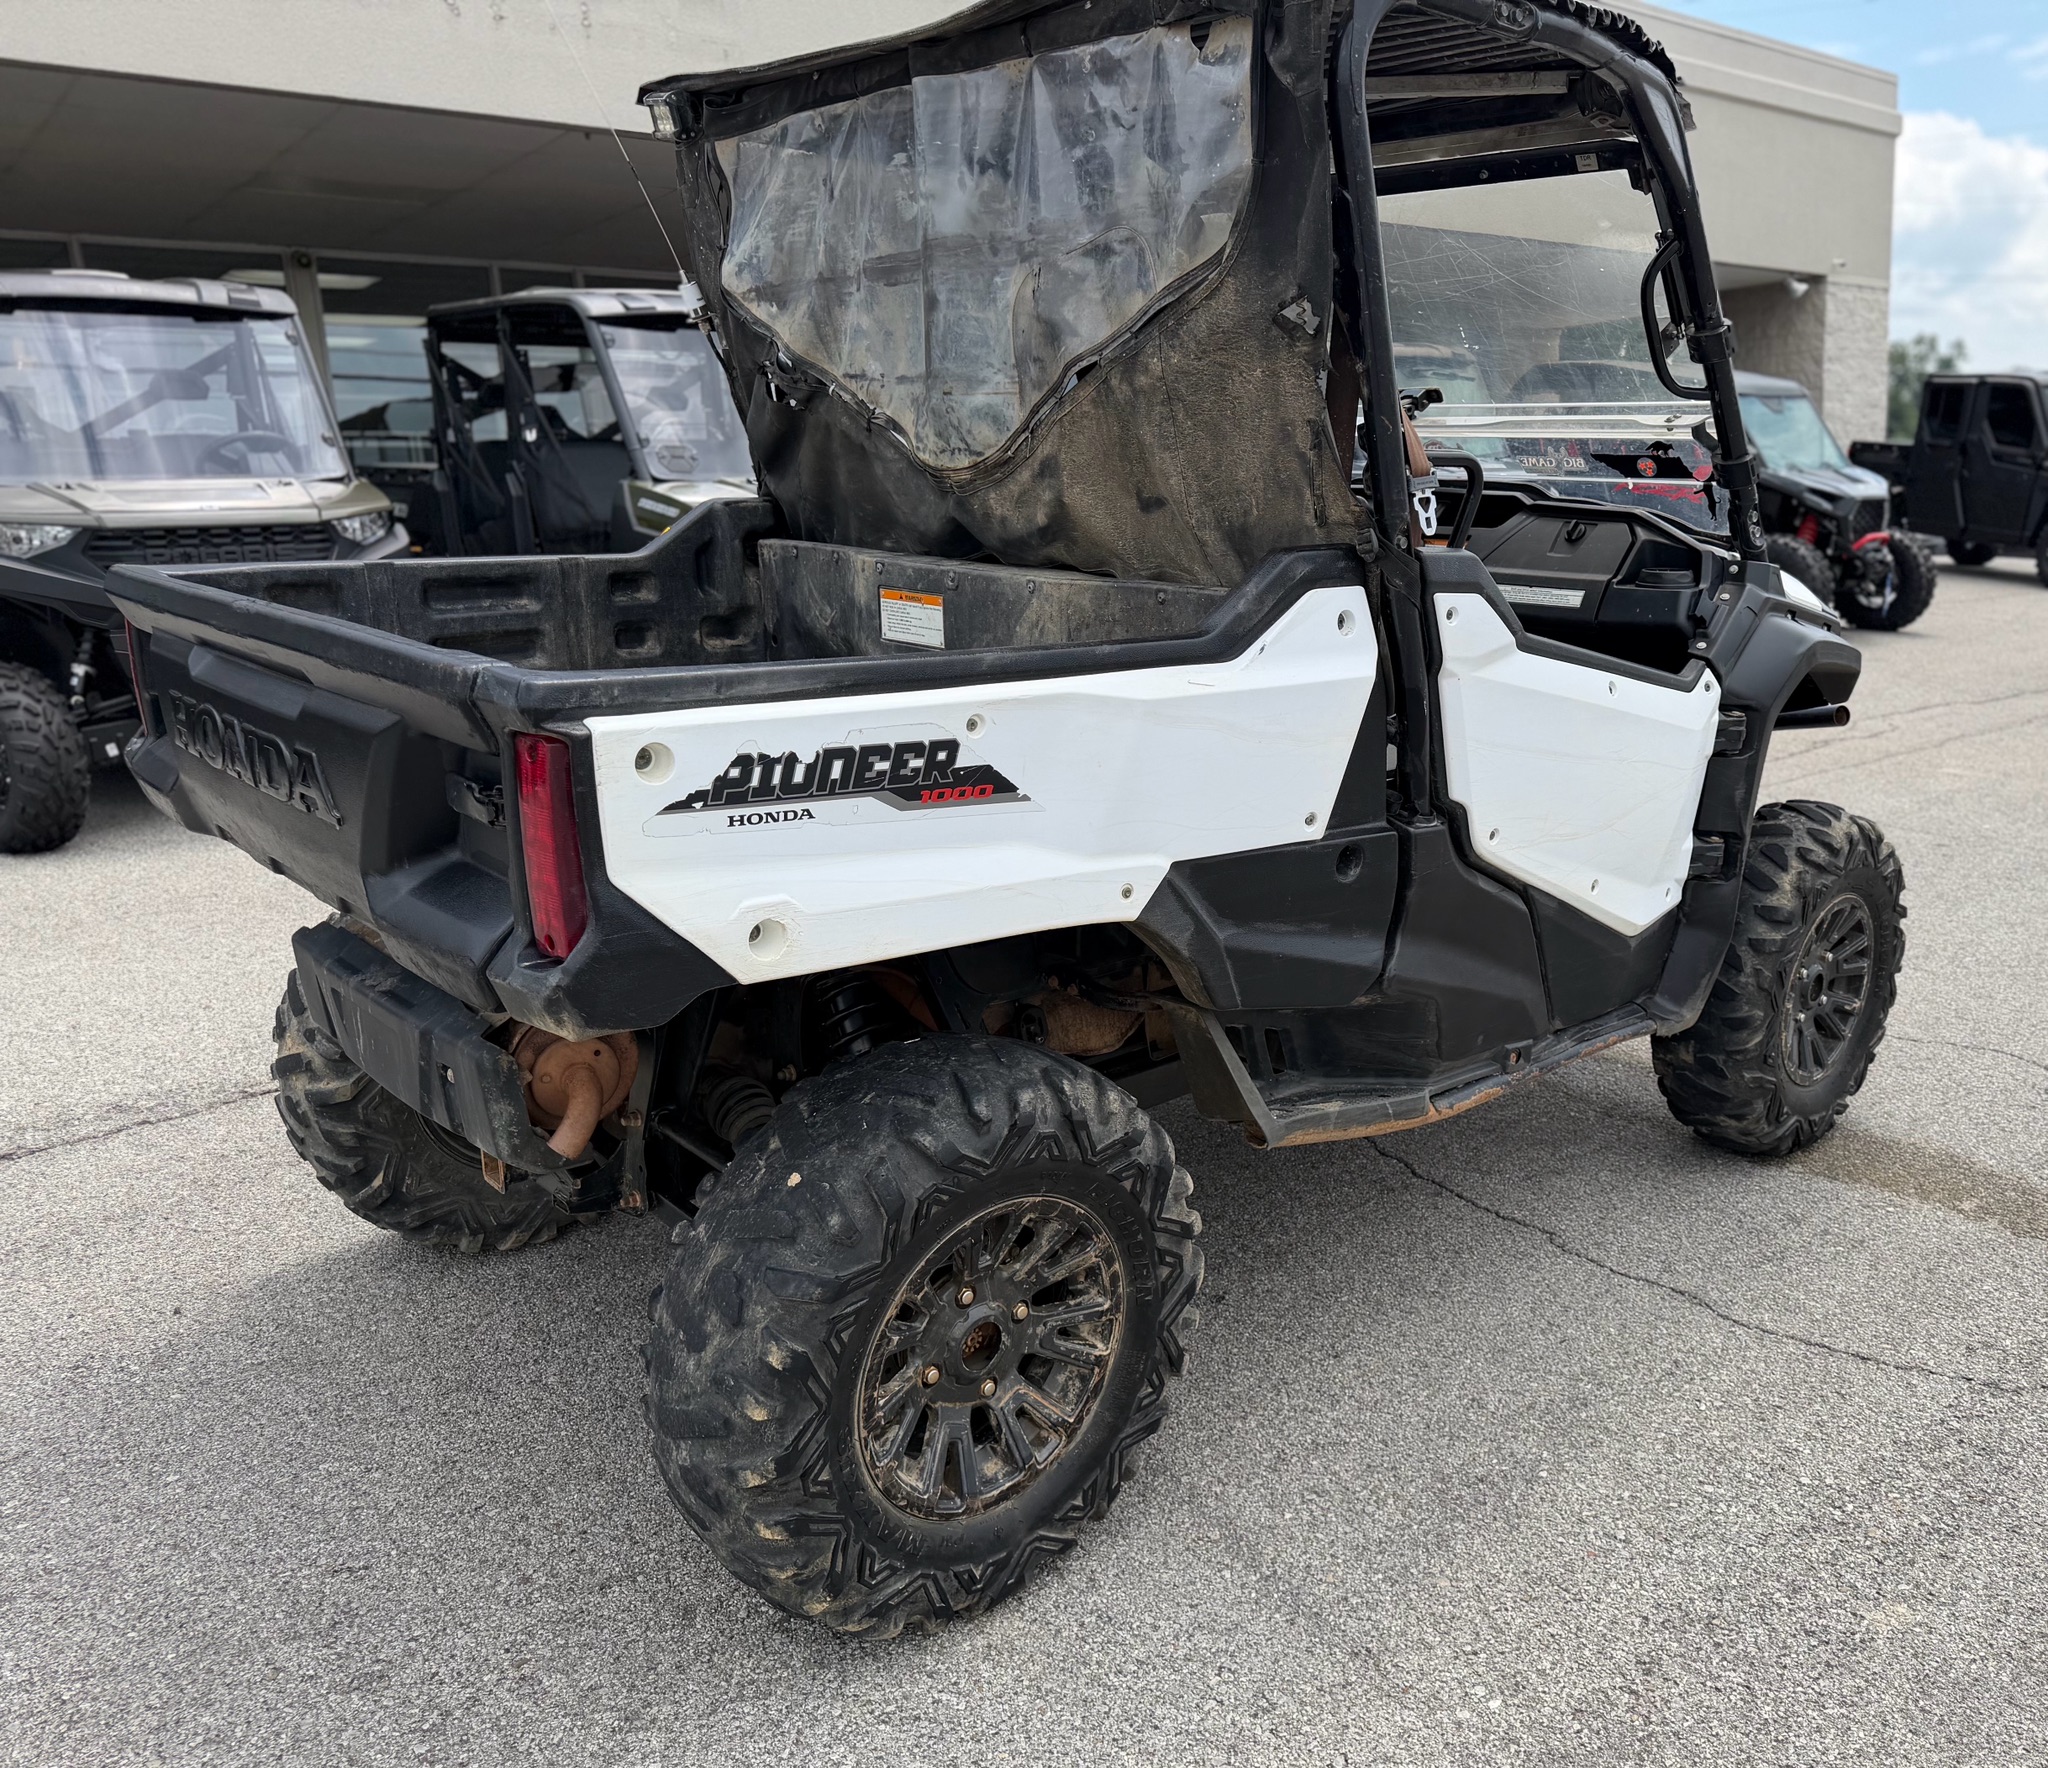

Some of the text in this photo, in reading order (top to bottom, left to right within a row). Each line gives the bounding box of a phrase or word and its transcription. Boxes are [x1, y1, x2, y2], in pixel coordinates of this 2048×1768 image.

[146, 543, 297, 564] POLARIS
[169, 689, 345, 831] HONDA
[707, 738, 961, 805] PIONEER
[920, 784, 994, 804] 1000
[727, 808, 816, 828] HONDA
